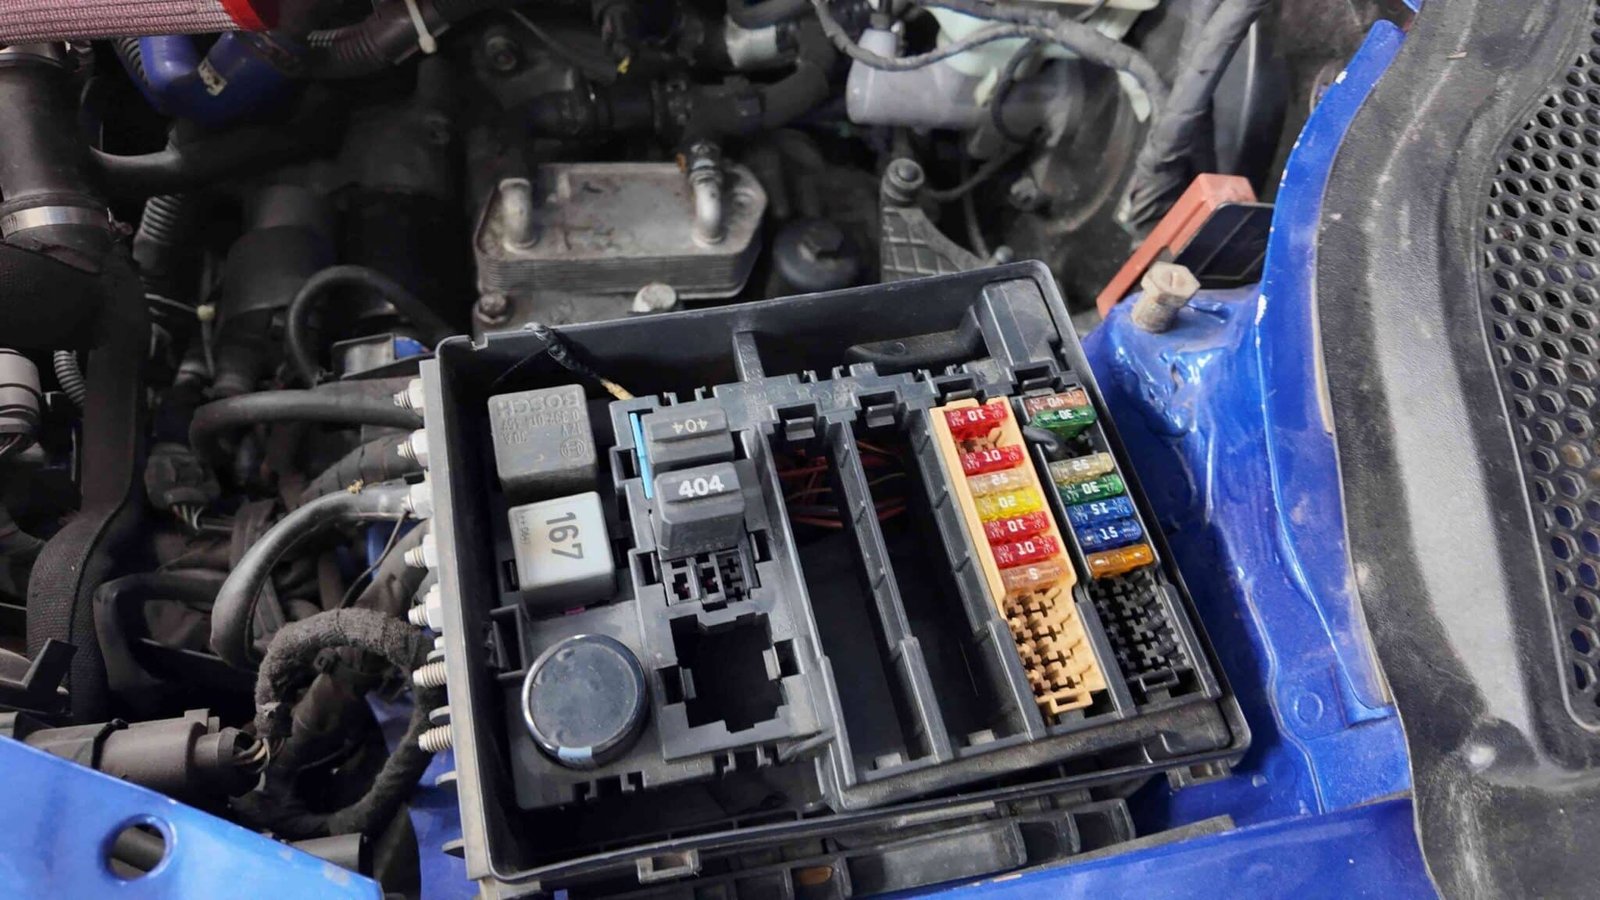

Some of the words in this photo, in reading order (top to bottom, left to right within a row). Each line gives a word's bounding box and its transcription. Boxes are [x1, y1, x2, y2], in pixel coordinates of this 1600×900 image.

[498, 391, 579, 416] BOSCH
[1047, 397, 1065, 408] 40
[967, 408, 986, 421] 10
[1058, 409, 1074, 420] 30
[672, 418, 708, 434] 404
[982, 449, 1002, 462] 10
[1072, 459, 1090, 471] 25
[991, 472, 1009, 486] 25
[678, 475, 724, 497] 404
[1081, 481, 1100, 494] 30
[998, 495, 1016, 508] 20
[1090, 502, 1109, 515] 15
[1007, 519, 1026, 532] 10
[545, 512, 584, 559] 167
[1100, 526, 1119, 540] 15
[1016, 541, 1036, 555] 10
